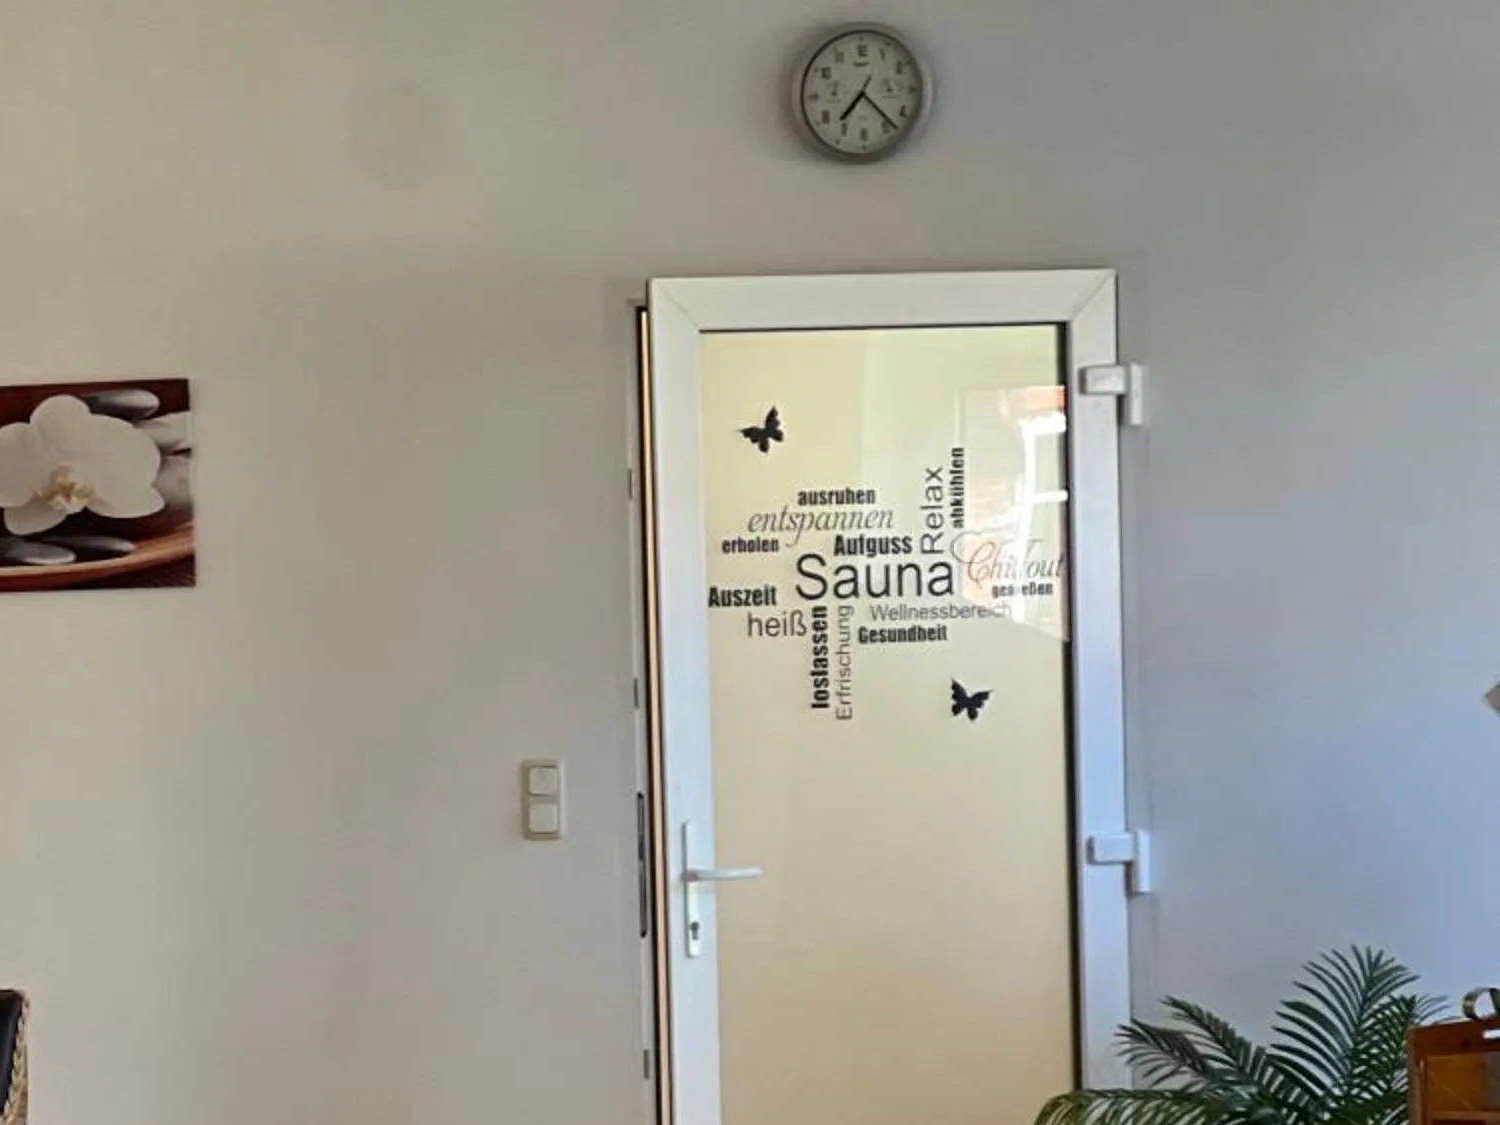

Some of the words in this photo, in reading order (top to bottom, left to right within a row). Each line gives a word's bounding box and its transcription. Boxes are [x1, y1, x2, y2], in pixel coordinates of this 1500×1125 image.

[797, 487, 876, 506] ausruhen
[920, 464, 944, 554] Relax
[747, 503, 894, 548] entspannen
[721, 537, 780, 554] erholen
[833, 533, 913, 558] Aufguss
[795, 553, 954, 600] Sauna
[991, 581, 1055, 599] geneßen
[708, 583, 777, 608] Auszeit
[747, 609, 808, 638] heiß
[858, 624, 947, 645] Gesundheit
[810, 605, 830, 709] loslassen
[835, 605, 854, 721] Erfrischung
